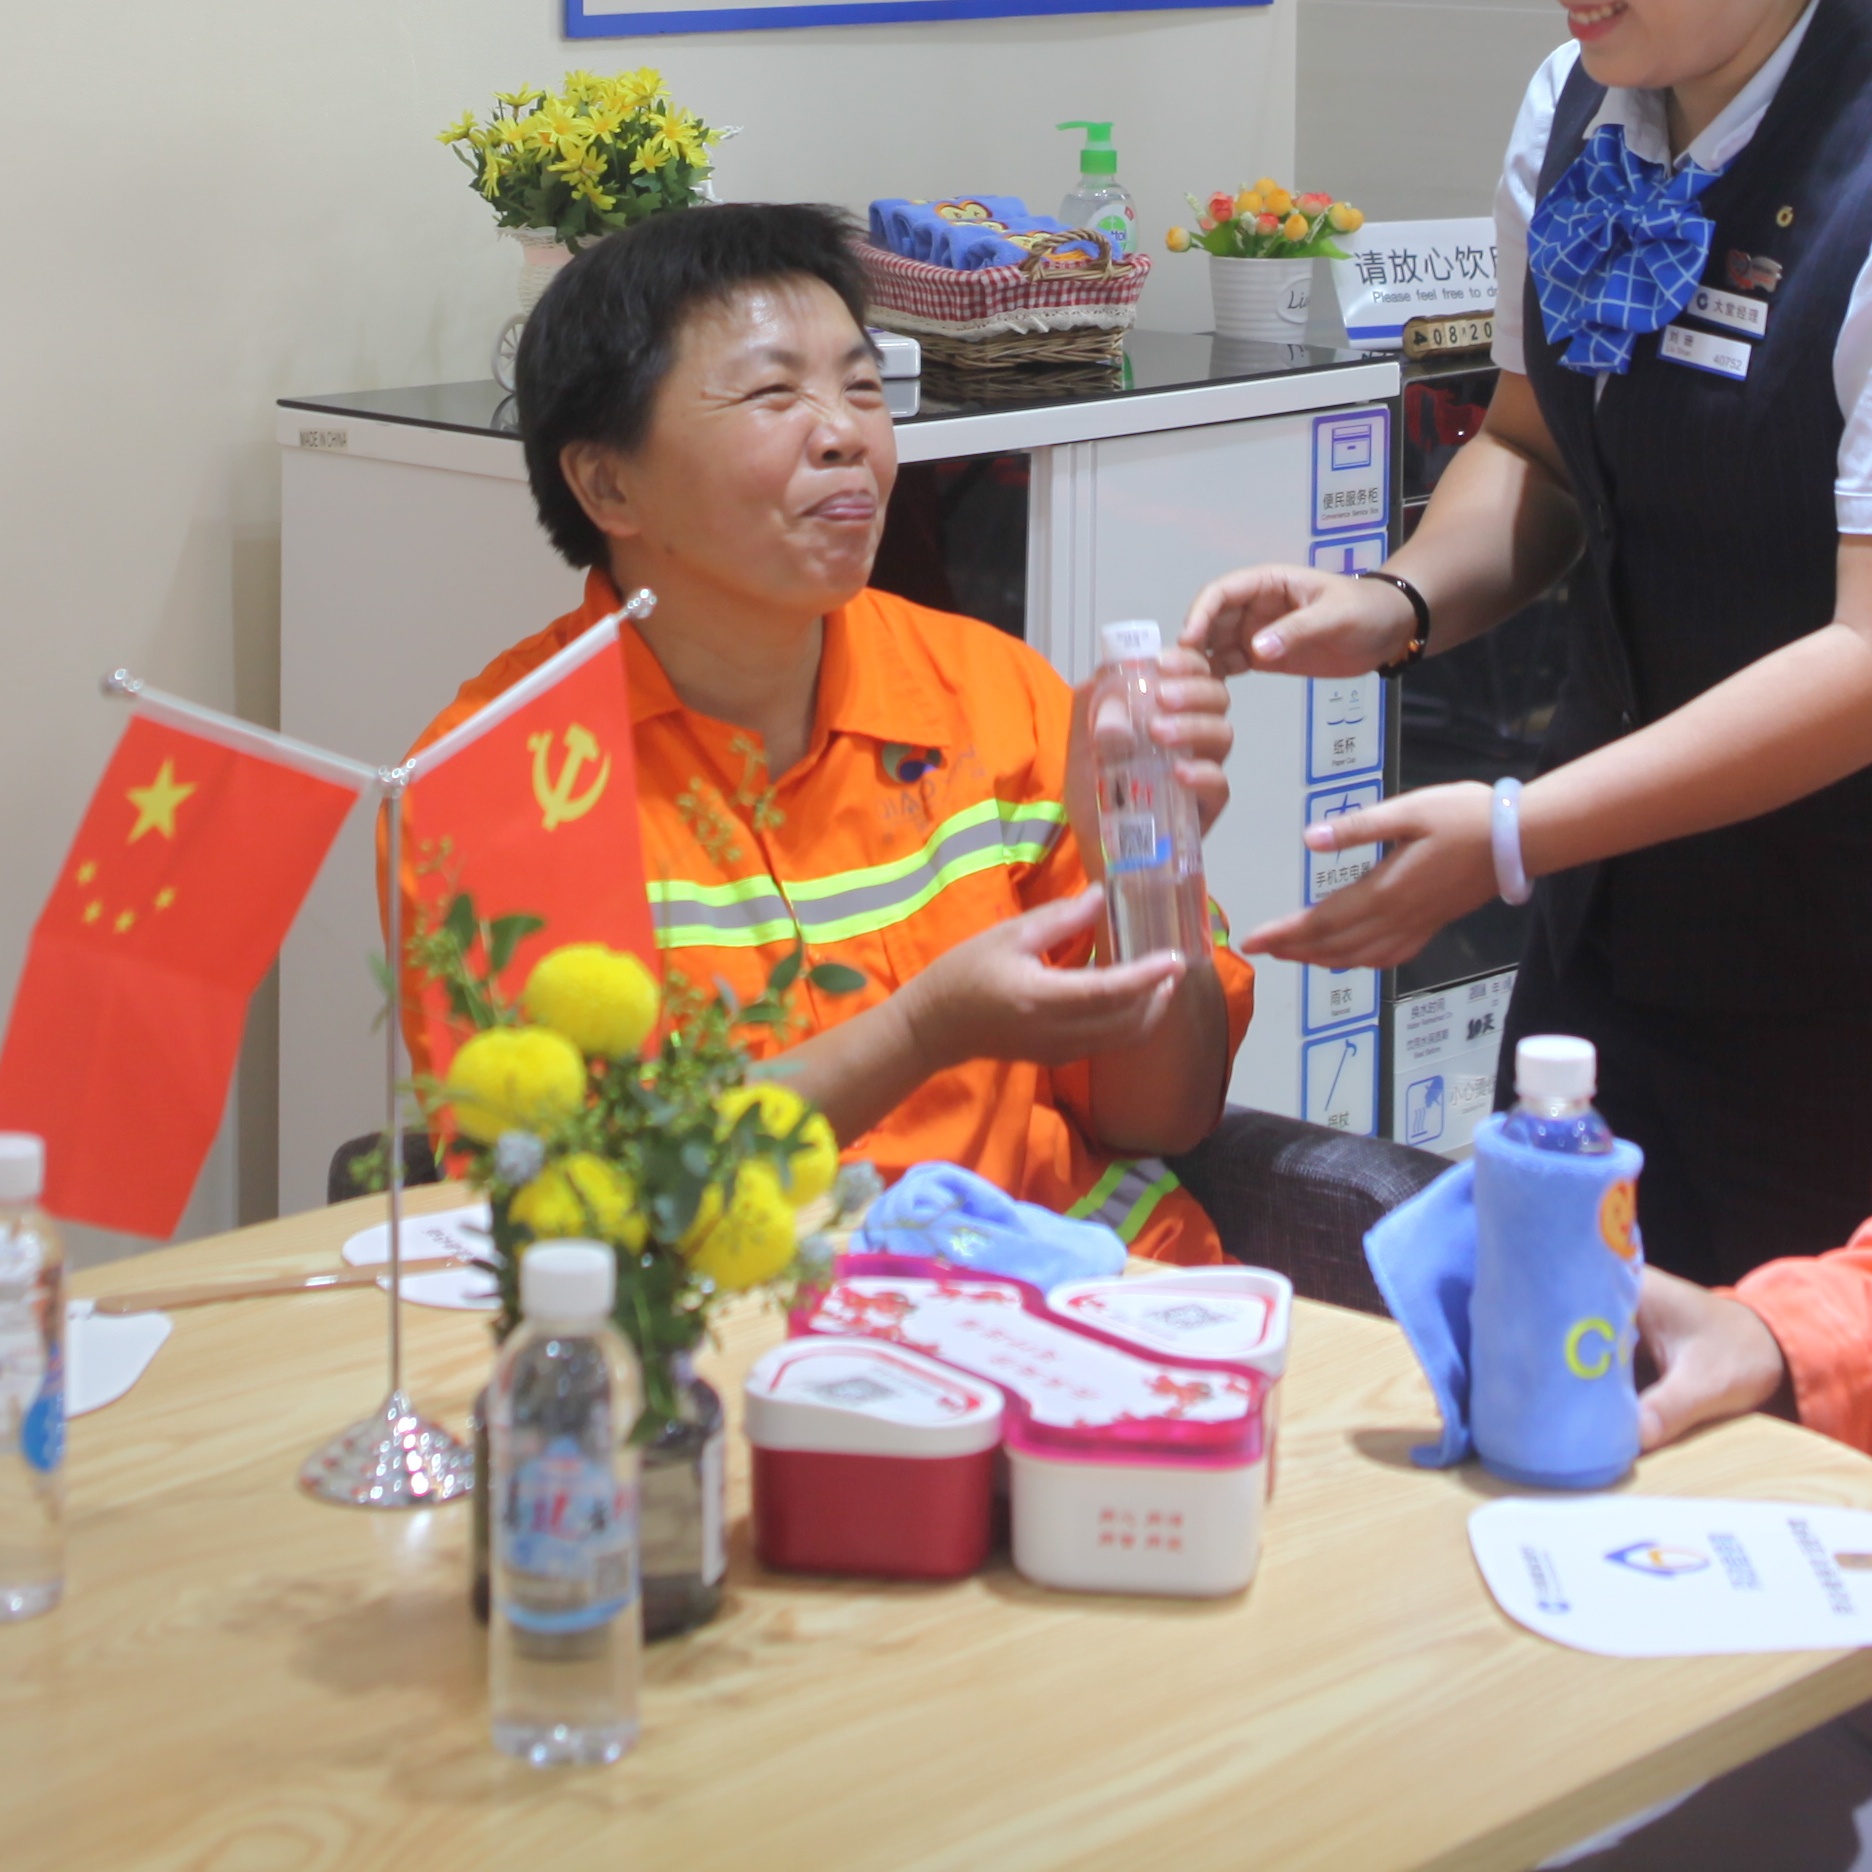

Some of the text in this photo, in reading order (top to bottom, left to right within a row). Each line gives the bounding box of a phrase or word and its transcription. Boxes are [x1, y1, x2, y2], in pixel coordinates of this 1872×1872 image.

[1372, 290, 1411, 303] Please
[1416, 289, 1438, 301] feel
[1442, 288, 1464, 299] free
[1469, 288, 1481, 298] to
[1323, 487, 1378, 509] 便民服务柜
[1334, 737, 1356, 754] 纸杯
[1331, 988, 1352, 1006] 雨衣
